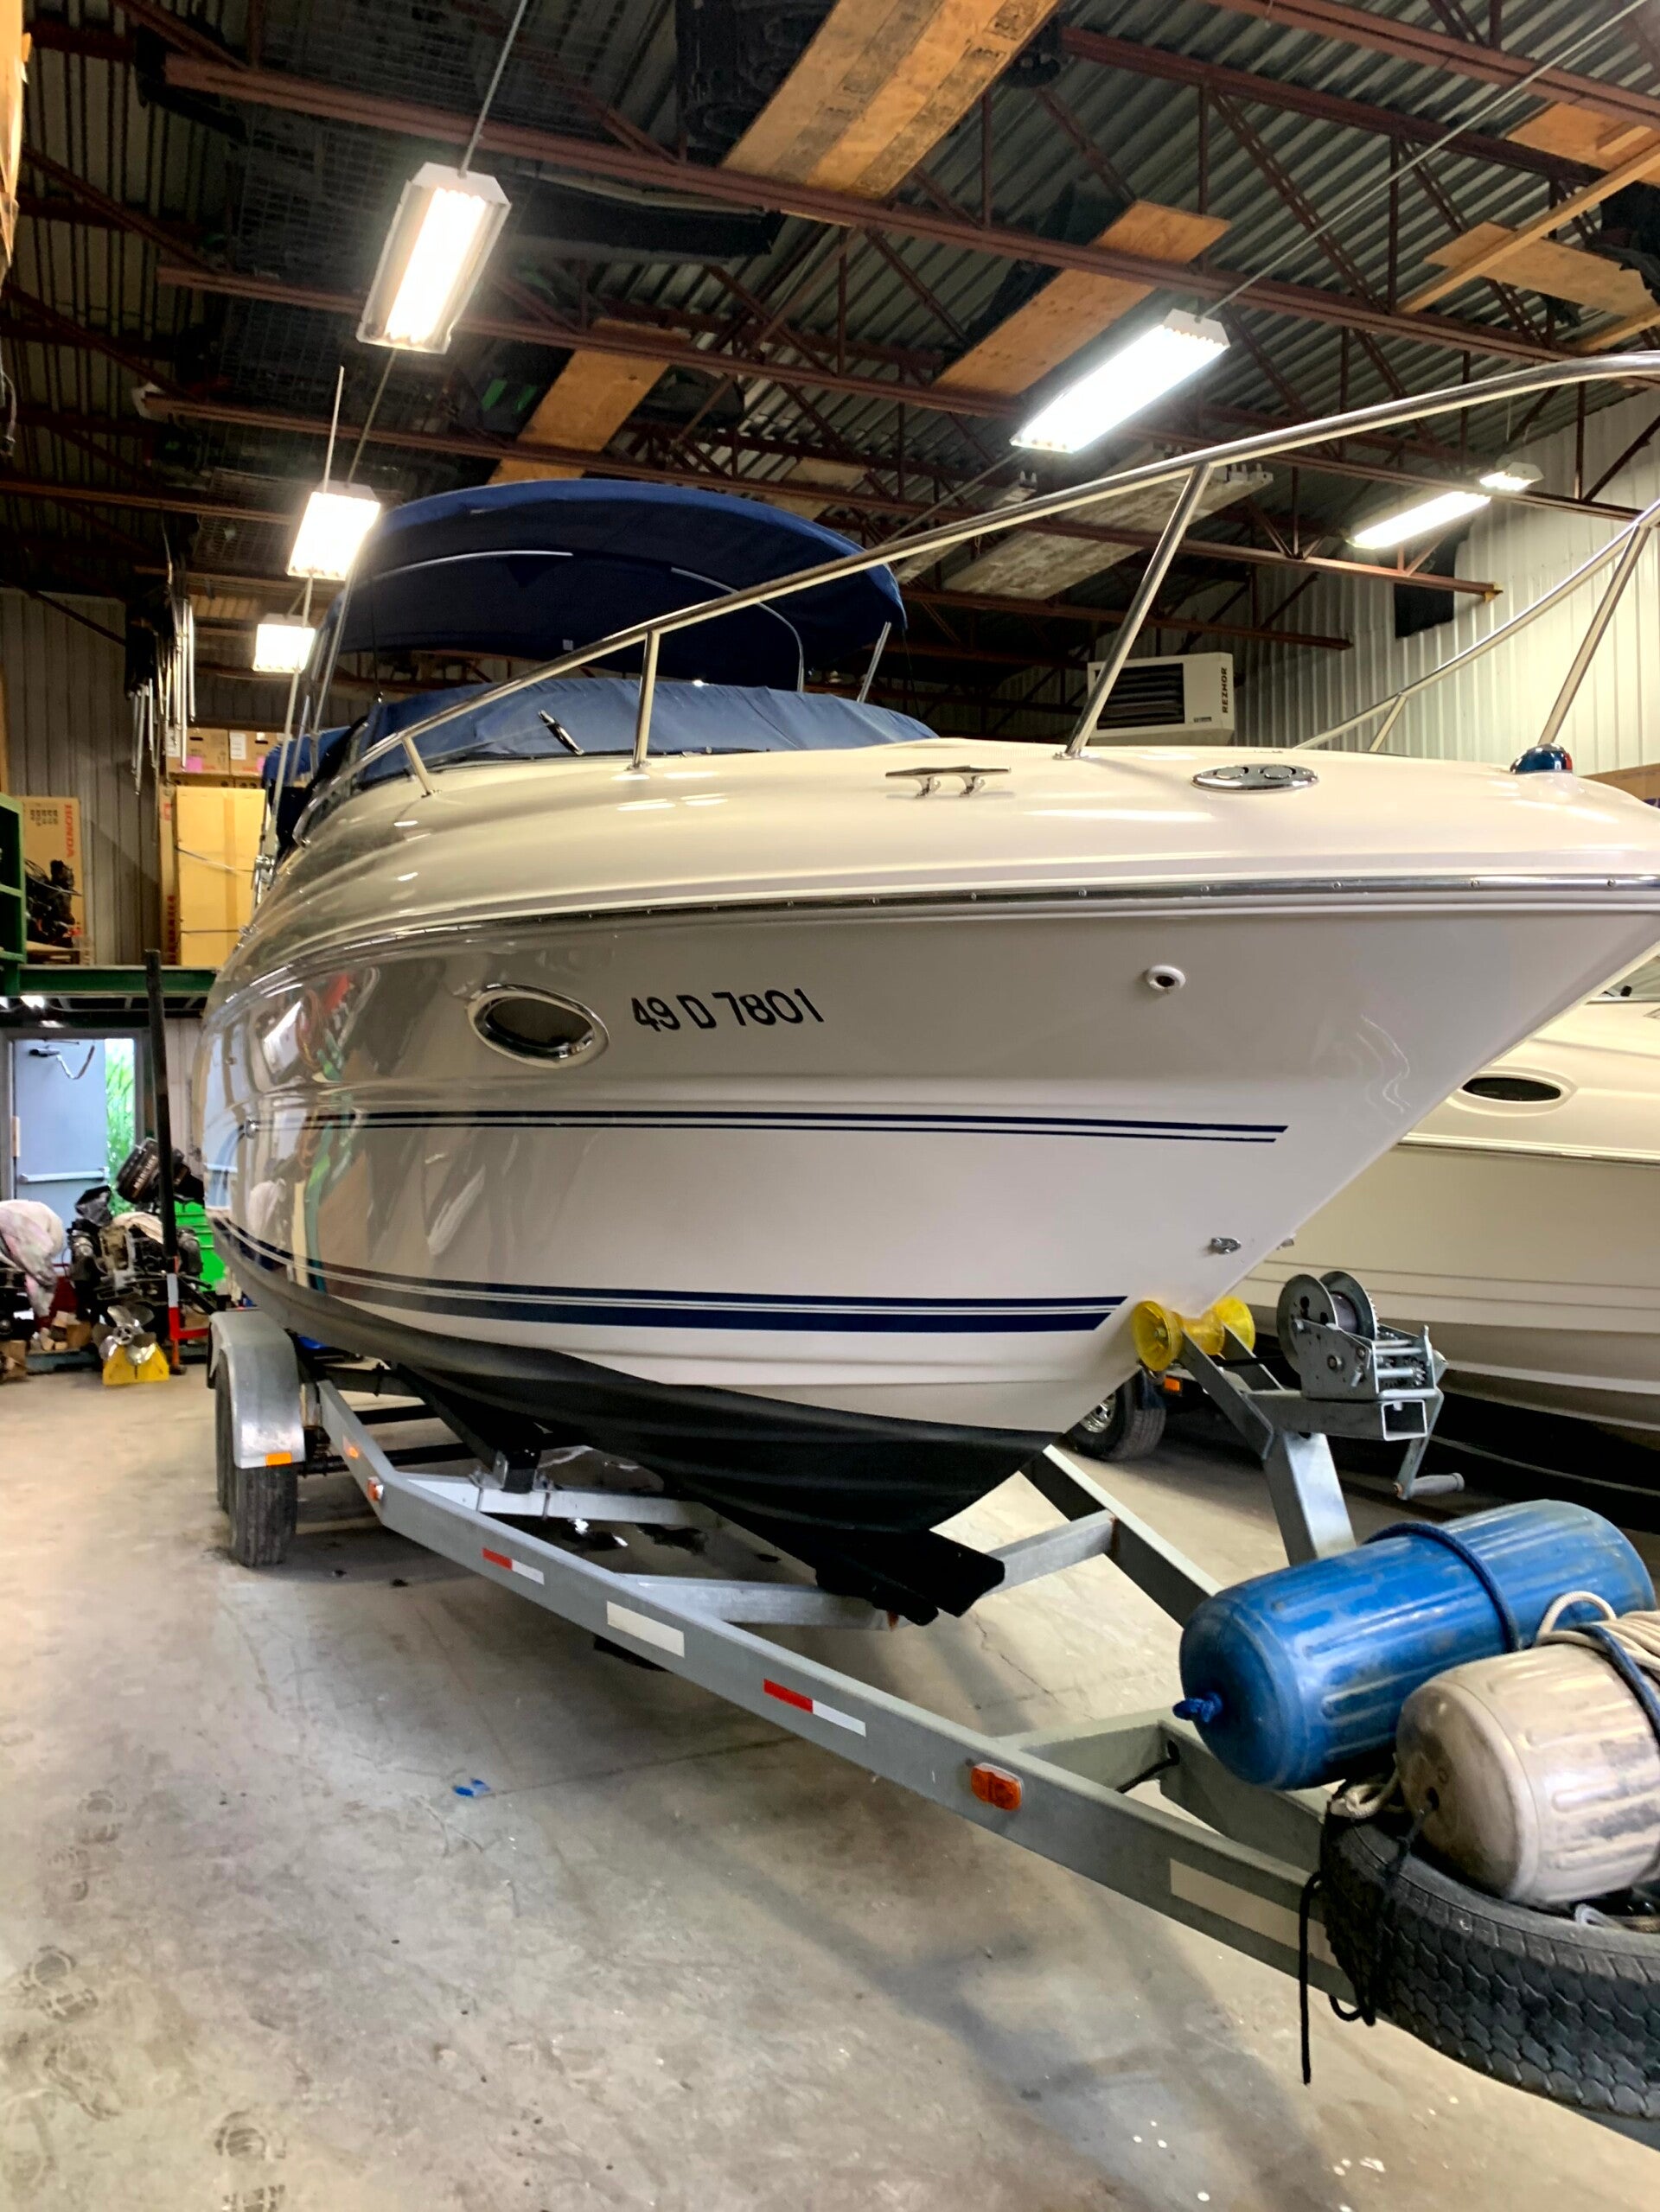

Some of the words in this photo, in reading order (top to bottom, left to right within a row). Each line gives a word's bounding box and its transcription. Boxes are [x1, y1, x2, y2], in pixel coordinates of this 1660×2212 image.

[64, 804, 74, 858] HONDA
[630, 997, 681, 1032] 49
[675, 994, 717, 1030] D
[711, 988, 825, 1027] 7801
